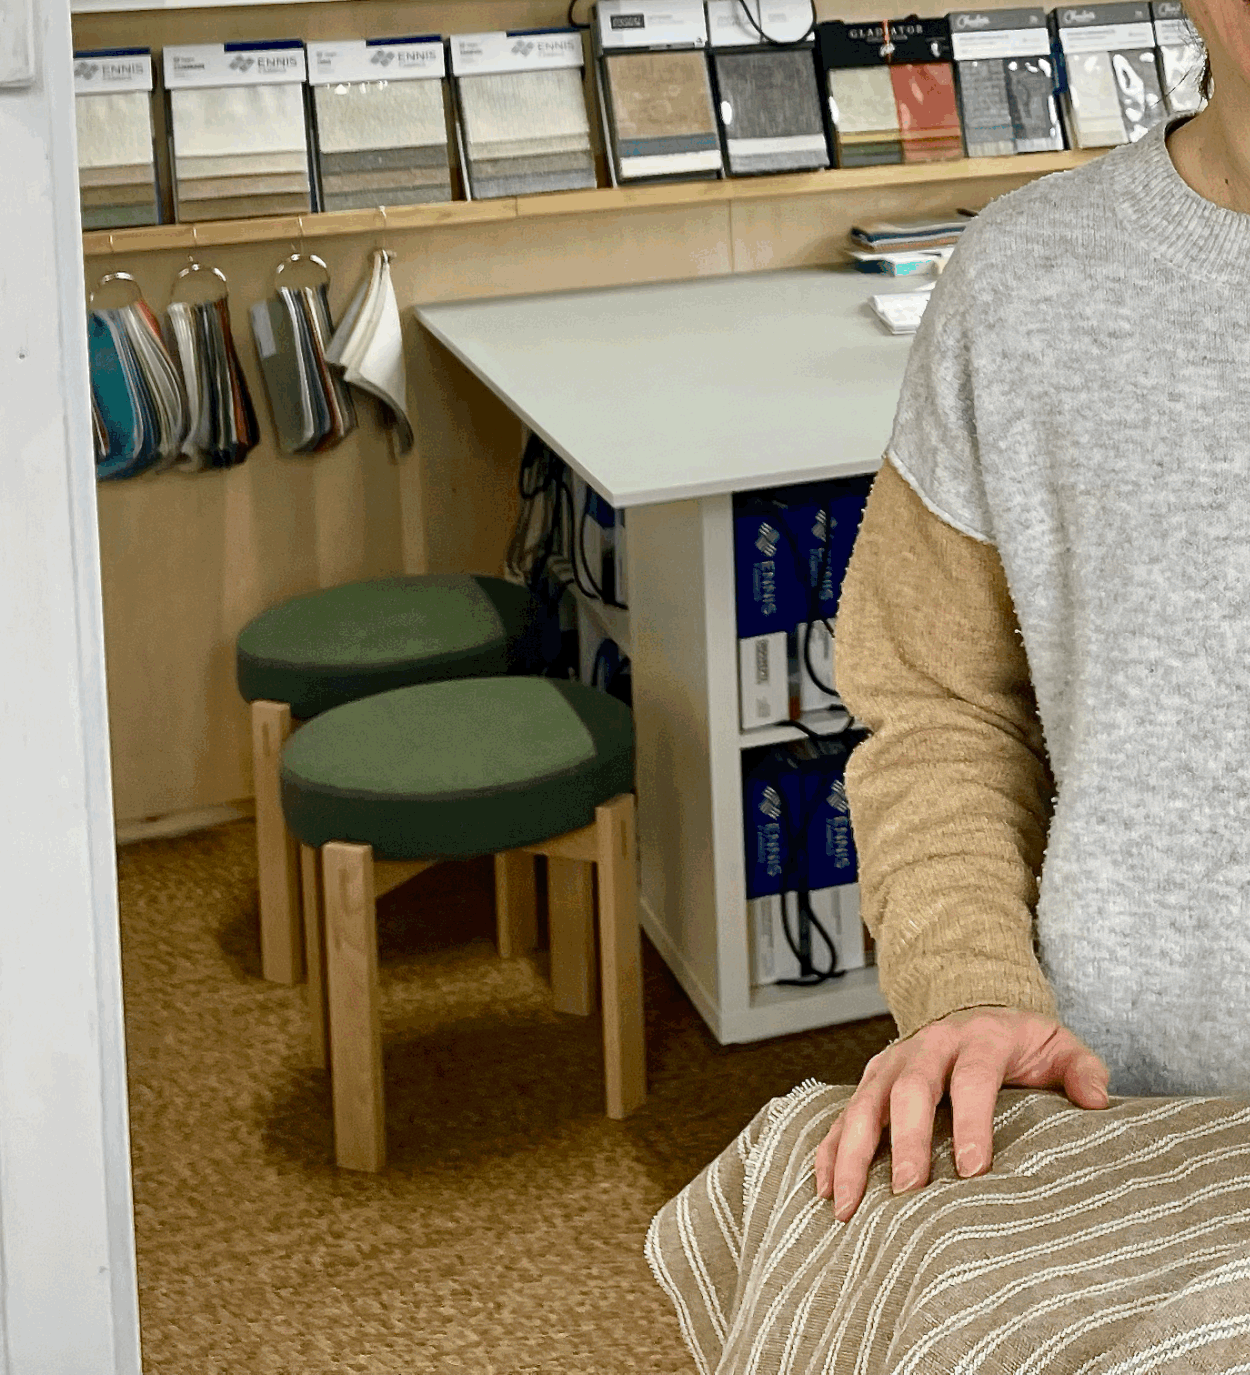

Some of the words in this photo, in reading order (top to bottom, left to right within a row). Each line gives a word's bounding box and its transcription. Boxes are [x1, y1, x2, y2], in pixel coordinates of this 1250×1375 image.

[537, 40, 575, 51] ENNIS
[257, 55, 297, 67] ENNIS
[398, 49, 437, 61] ENNIS
[102, 61, 144, 75] ENNIS
[761, 560, 777, 616] ENNIS
[834, 816, 850, 869] ENNIS
[766, 823, 782, 877] ENNIS
